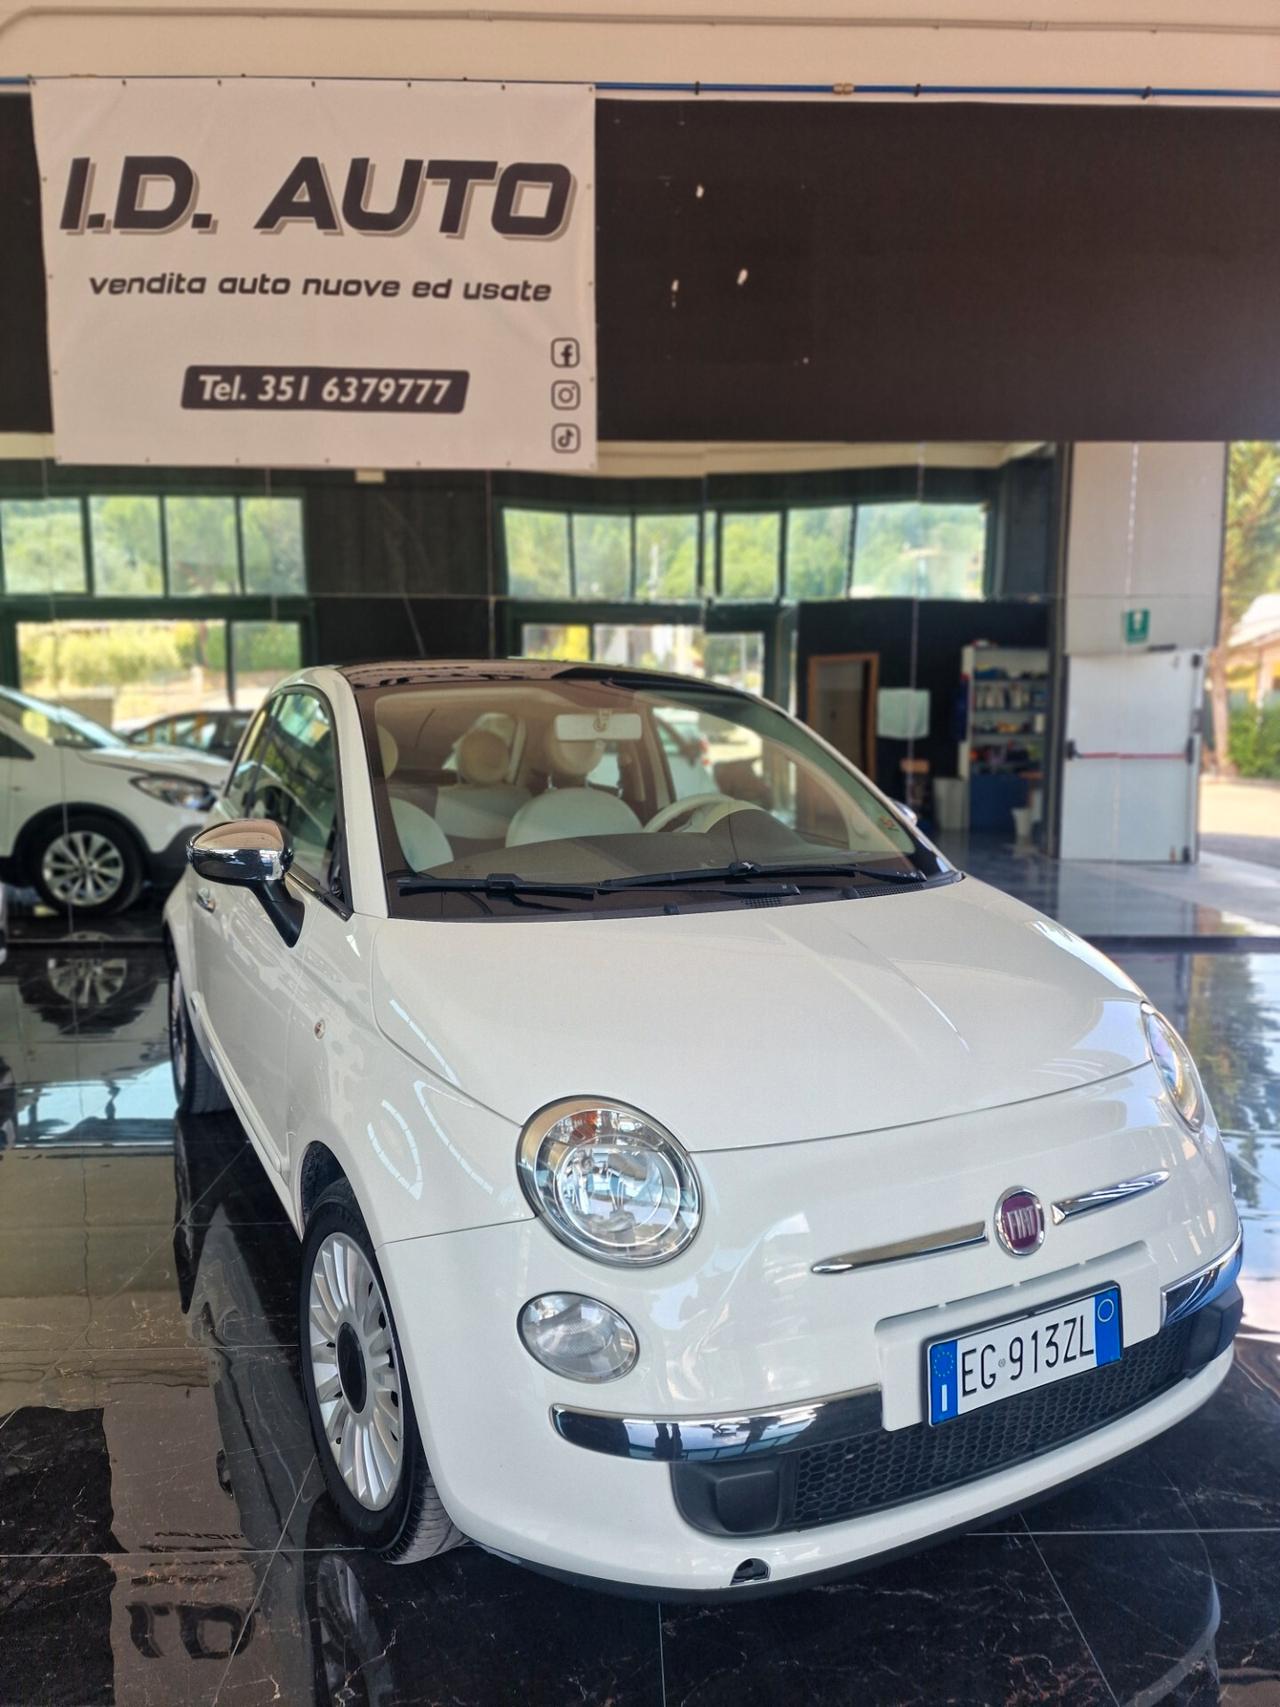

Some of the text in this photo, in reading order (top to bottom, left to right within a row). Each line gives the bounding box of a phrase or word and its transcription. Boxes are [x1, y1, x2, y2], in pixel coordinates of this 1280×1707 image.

[60, 155, 577, 241] I.D. AUTO
[89, 272, 553, 302] vendita auto nuove ed usate
[199, 374, 452, 404] Tel. 351 6379777
[1006, 1205, 1035, 1241] FIAT
